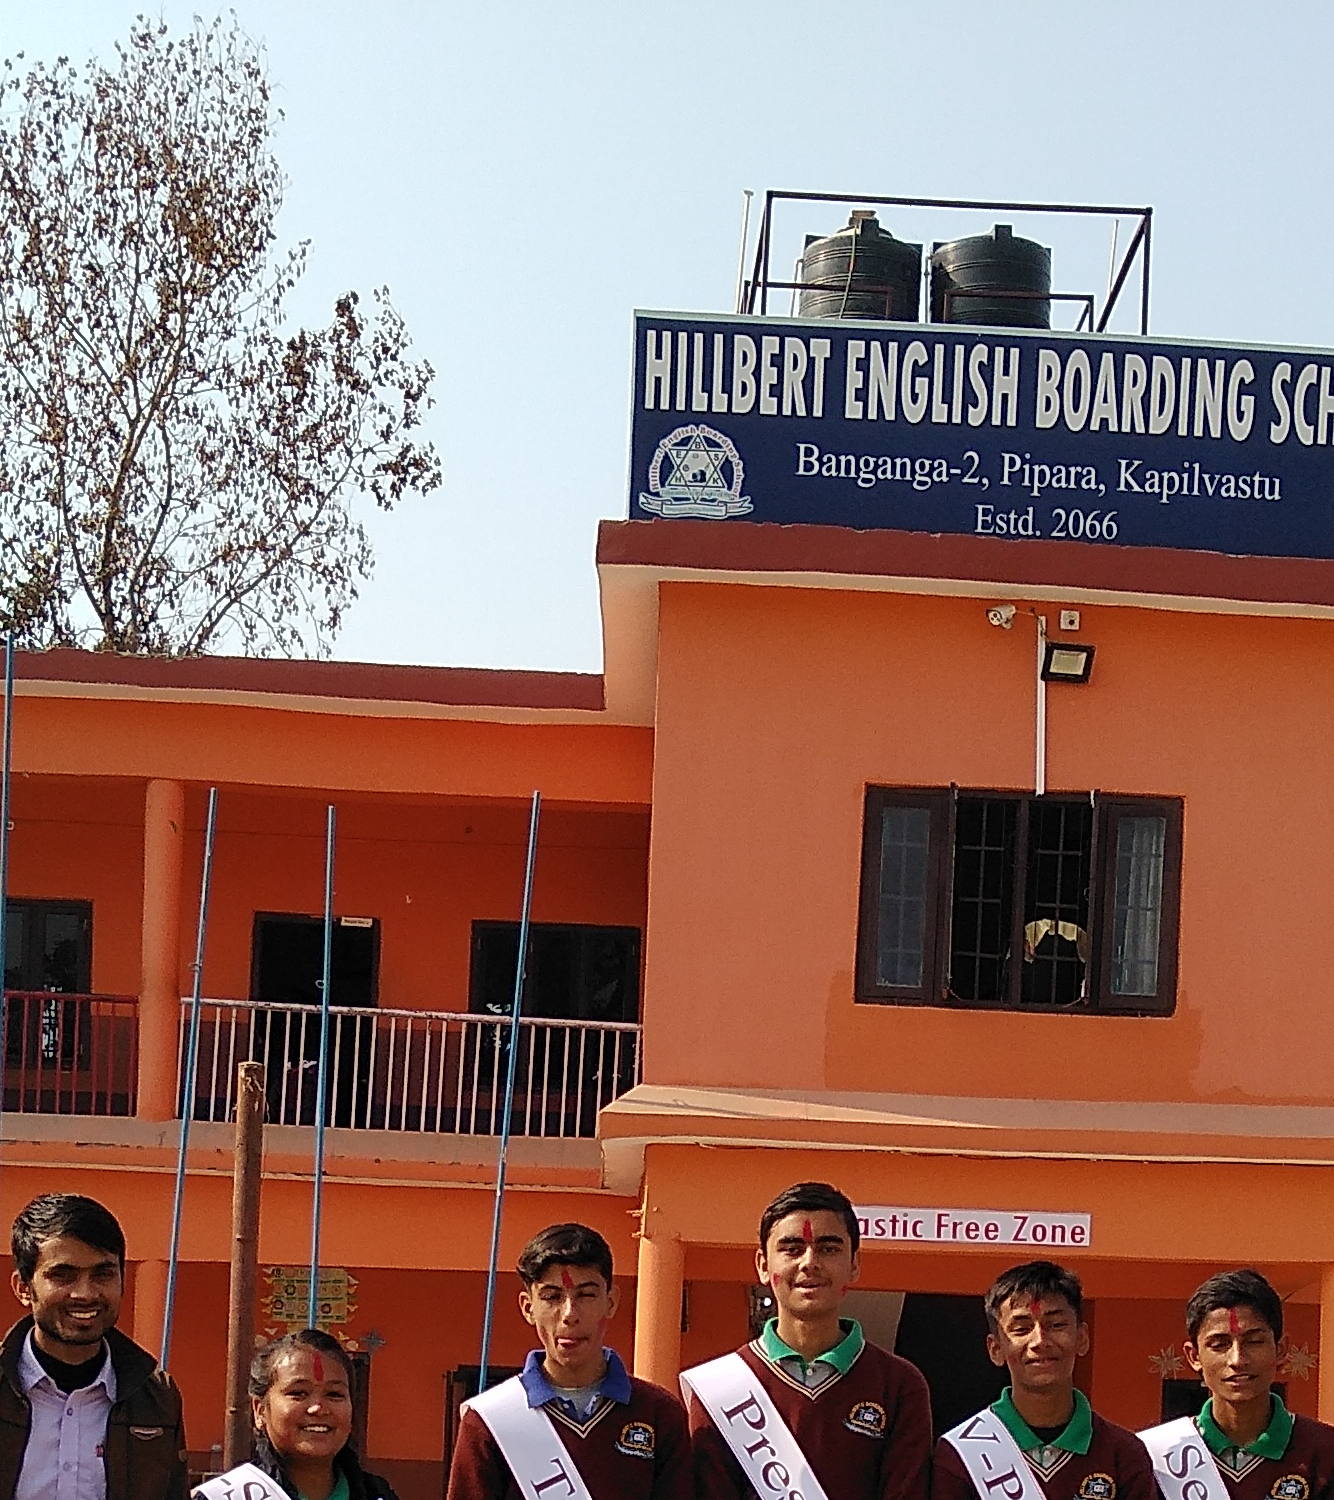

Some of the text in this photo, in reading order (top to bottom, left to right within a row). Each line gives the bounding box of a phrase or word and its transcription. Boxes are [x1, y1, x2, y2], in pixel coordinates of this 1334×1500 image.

[644, 329, 831, 418] HILLBERT
[844, 339, 1020, 428] ENGLISH
[1035, 348, 1255, 442] BOARDING
[796, 443, 1281, 503] Banganga-2, Pipara, Kapilvastu
[974, 505, 1118, 540] Estd. 2066
[858, 1212, 1086, 1244] astic Free Zone
